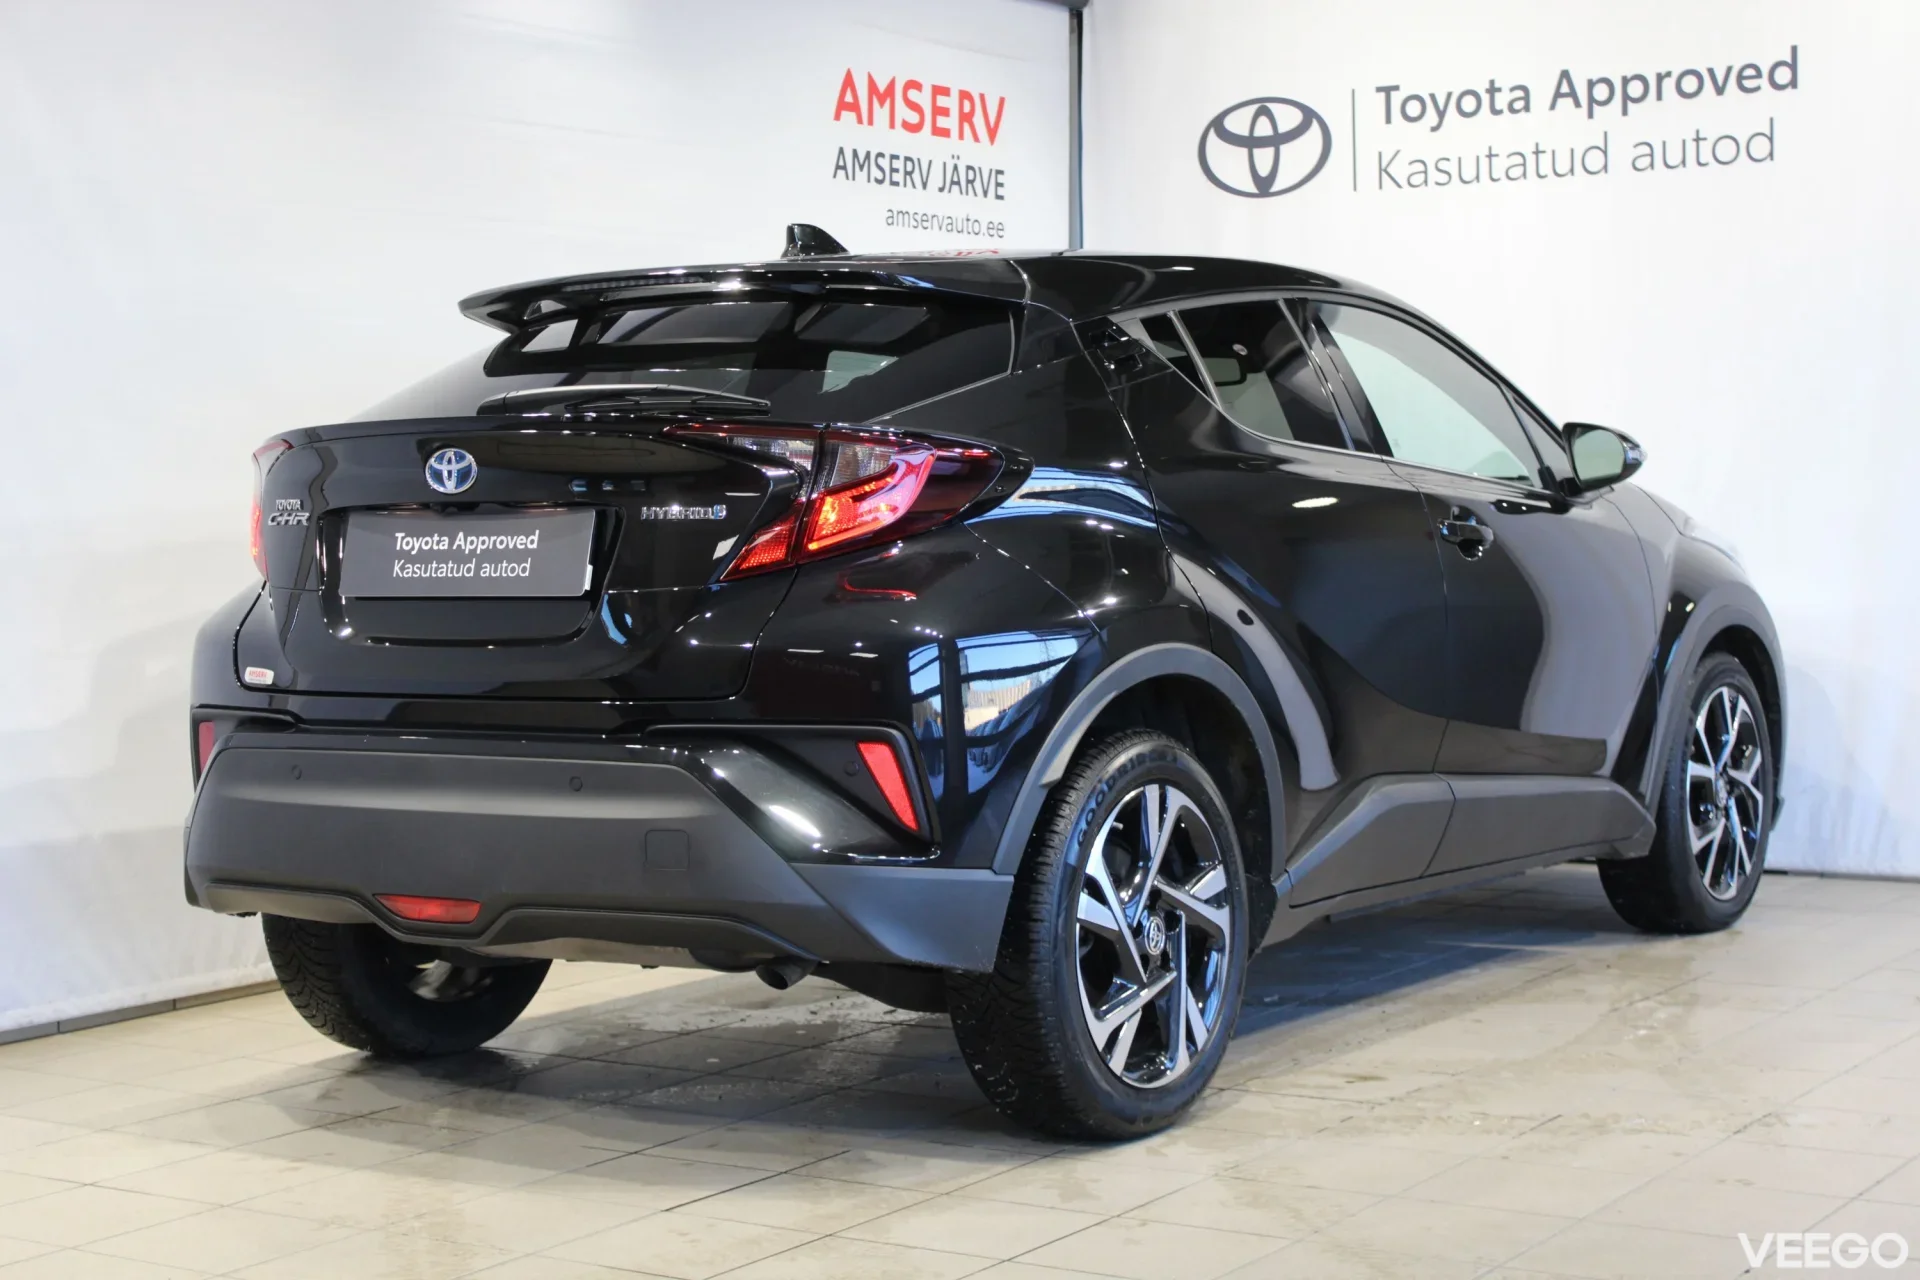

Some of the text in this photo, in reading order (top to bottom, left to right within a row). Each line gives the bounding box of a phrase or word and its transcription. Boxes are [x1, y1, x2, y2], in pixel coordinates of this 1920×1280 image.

[1375, 45, 1800, 132] Toyota Approved
[833, 67, 1006, 146] AMSERV
[1378, 117, 1776, 190] Kasutatud autod
[833, 146, 1005, 200] AMSERV JÄRVE
[886, 208, 1005, 238] amservauto.ee
[275, 499, 301, 511] TOYOTA
[641, 505, 712, 520] HYBRID
[395, 530, 540, 555] Toyota Approved
[393, 557, 531, 578] Kasutatud autod
